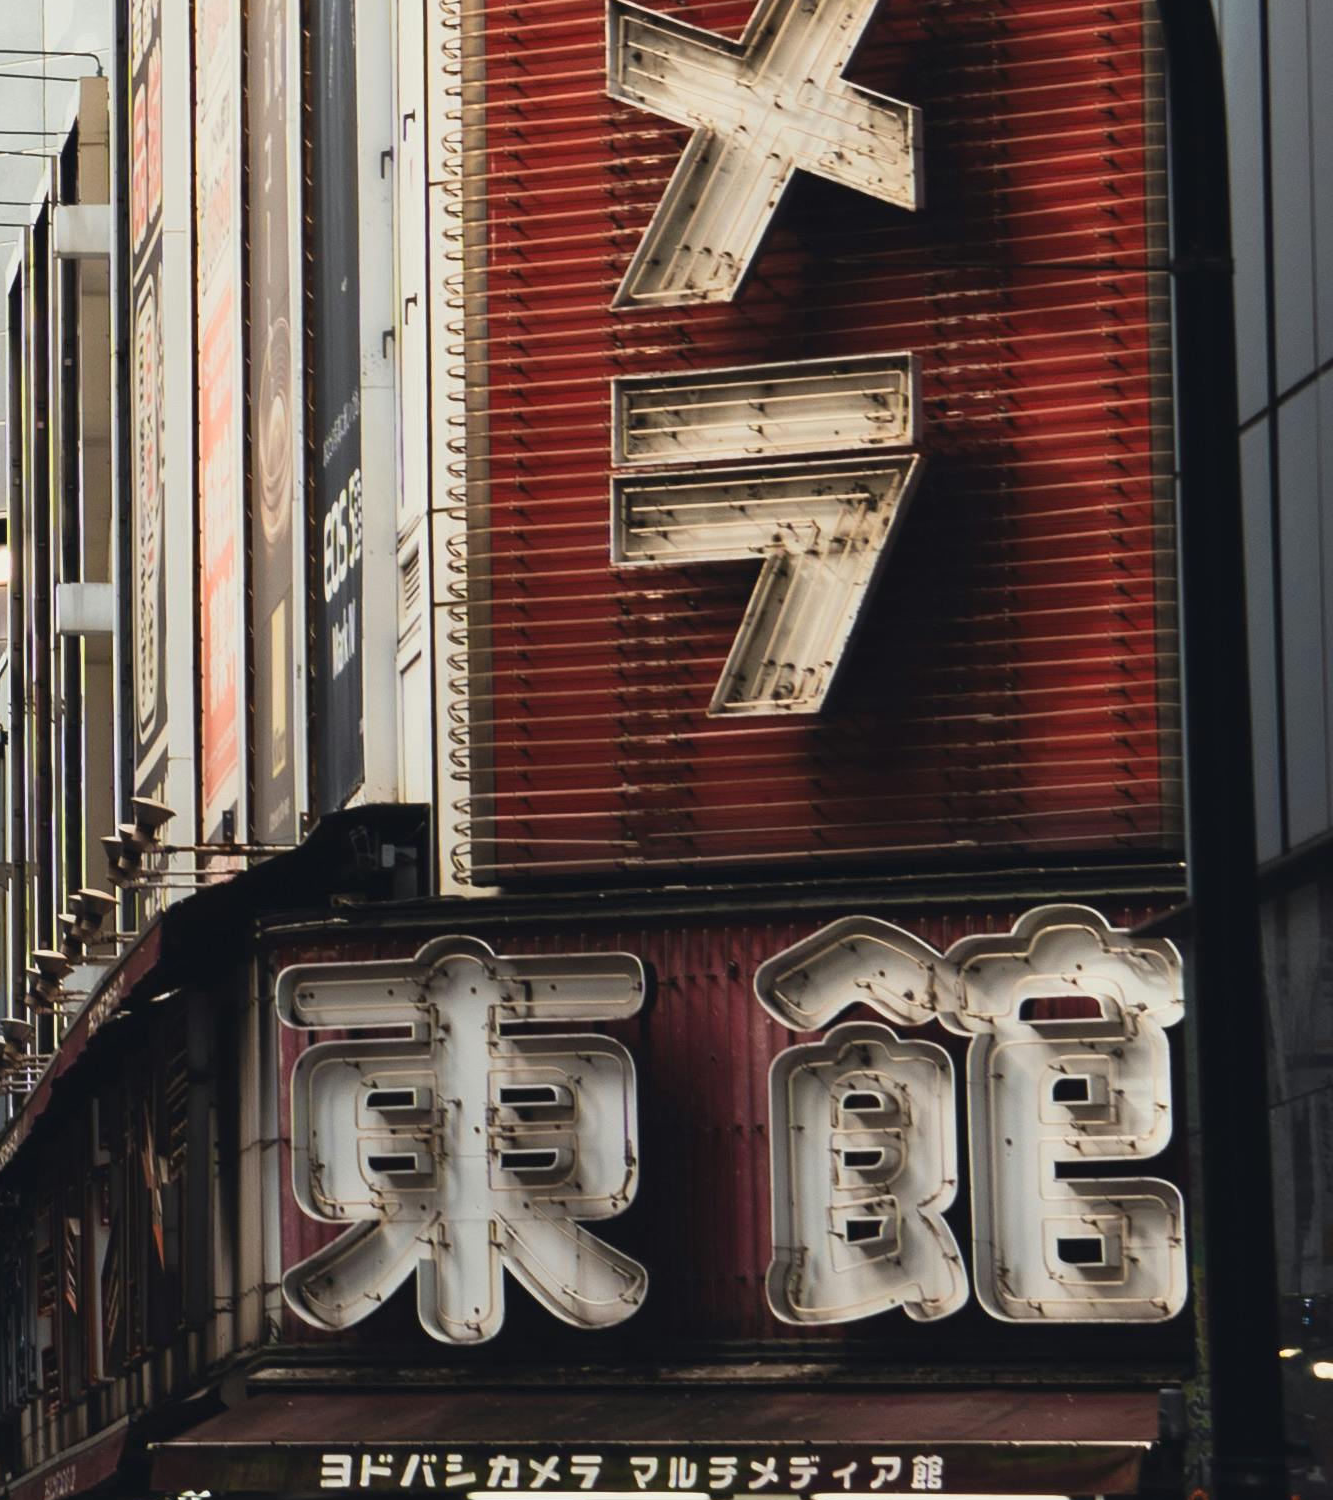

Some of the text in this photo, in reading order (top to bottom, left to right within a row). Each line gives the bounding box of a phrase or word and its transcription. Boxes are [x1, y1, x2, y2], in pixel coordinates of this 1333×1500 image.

[275, 903, 1189, 1344] 東館
[319, 1452, 948, 1494] ヨドバシカメラ マルチメディア館
